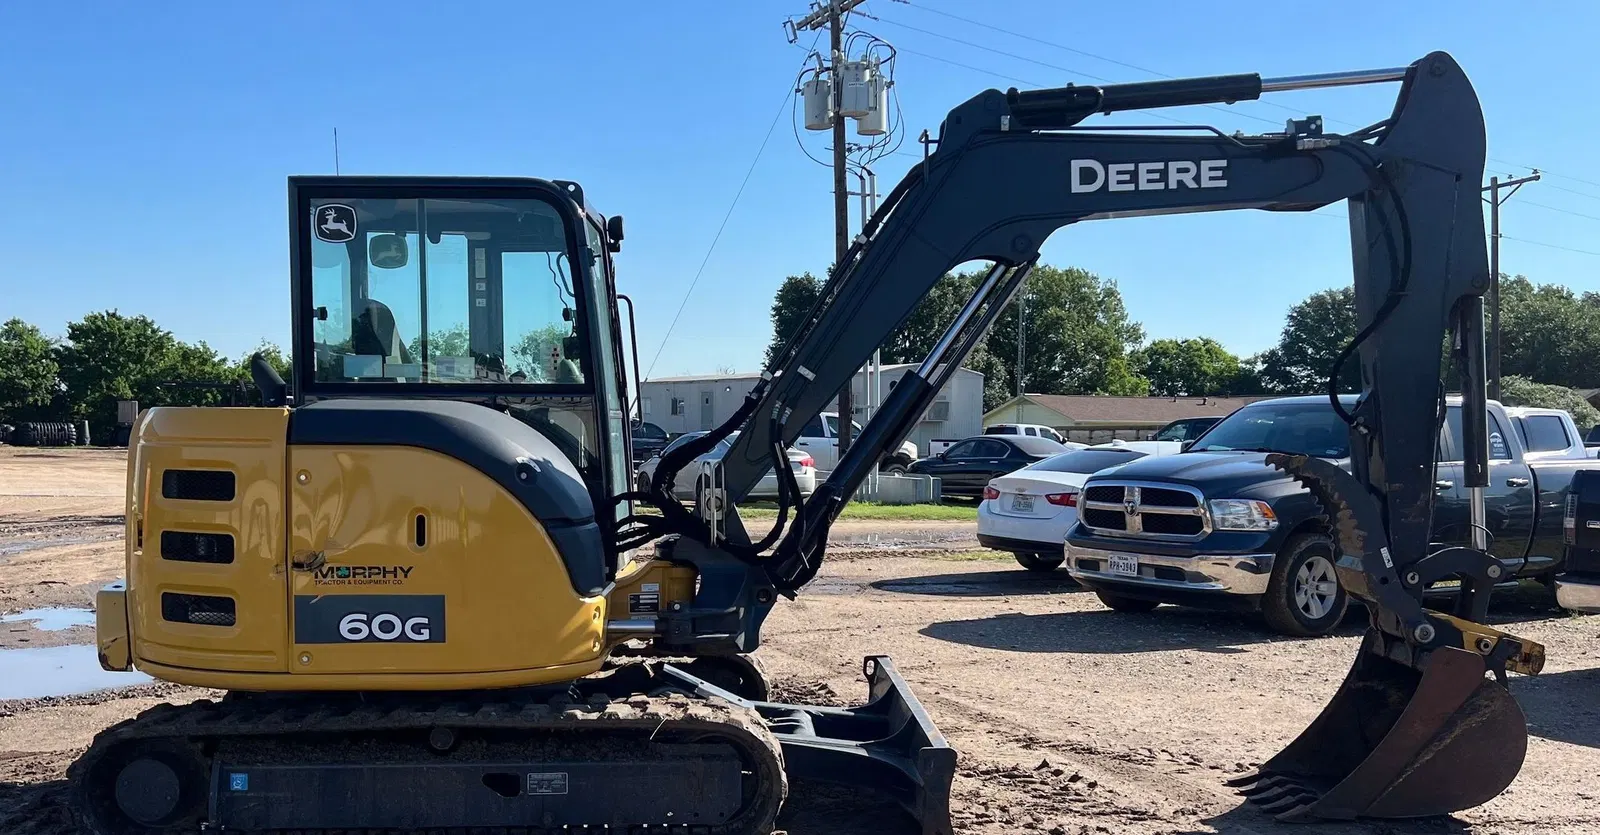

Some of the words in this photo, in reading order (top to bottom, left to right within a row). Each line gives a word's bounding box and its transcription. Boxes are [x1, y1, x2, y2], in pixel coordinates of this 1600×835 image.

[1071, 159, 1228, 193] DEERE
[314, 566, 414, 579] MURPHY
[339, 613, 430, 641] 60G
